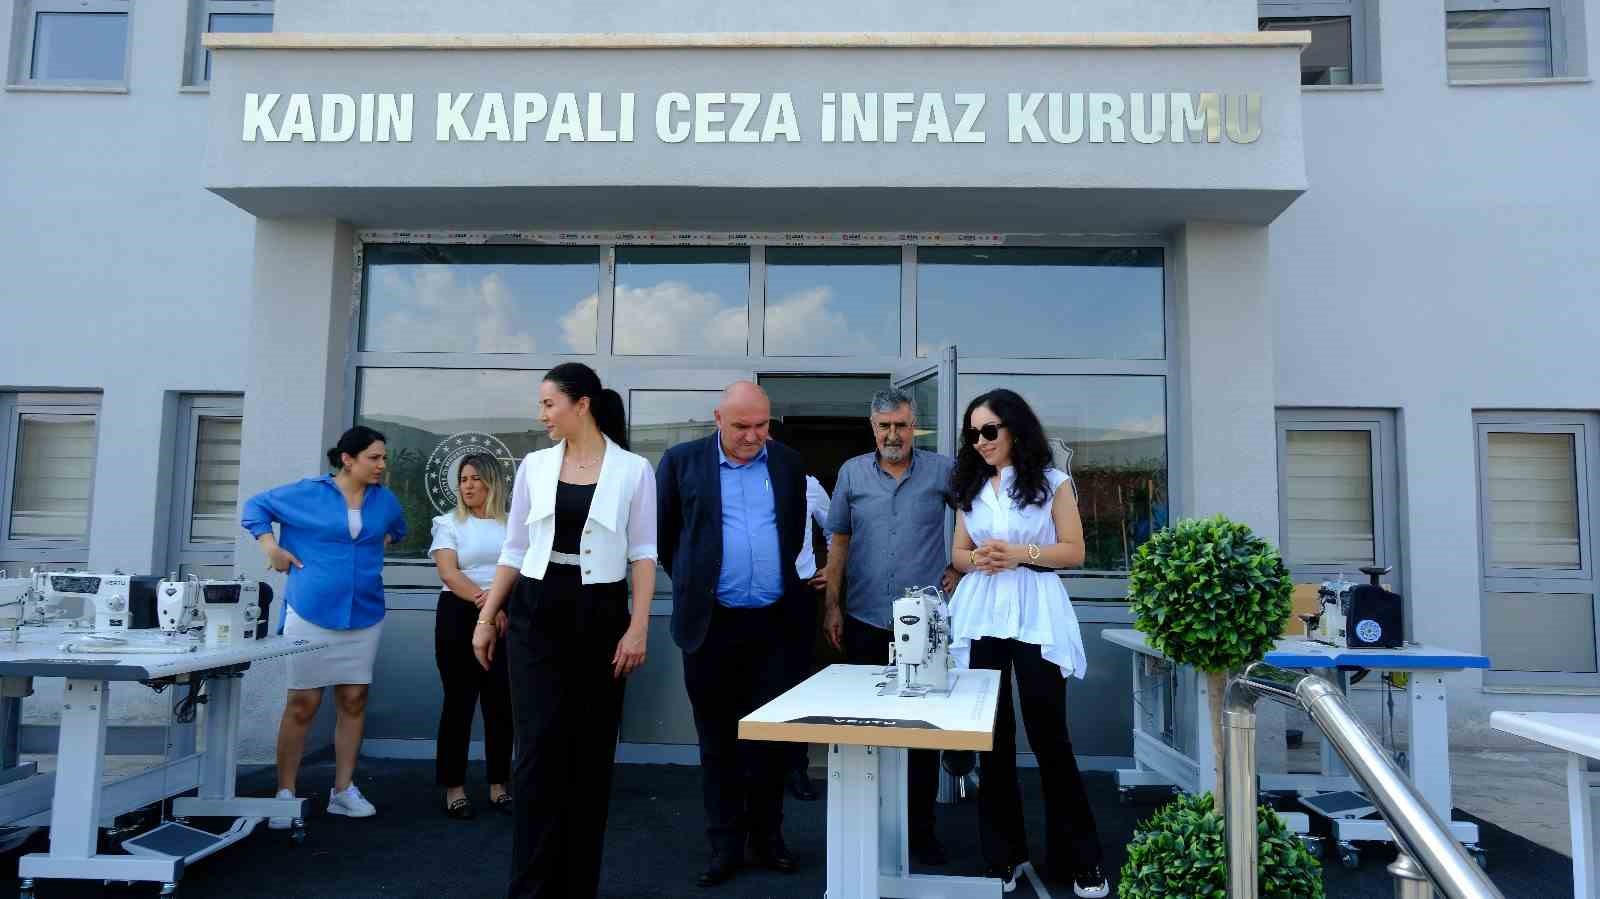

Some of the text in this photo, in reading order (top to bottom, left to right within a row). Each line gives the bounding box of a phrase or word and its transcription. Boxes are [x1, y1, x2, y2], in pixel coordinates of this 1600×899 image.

[242, 92, 414, 143] KADIN
[436, 92, 636, 143] KAPALI
[655, 91, 801, 144] CEZA
[1007, 91, 1264, 144] KURUMU
